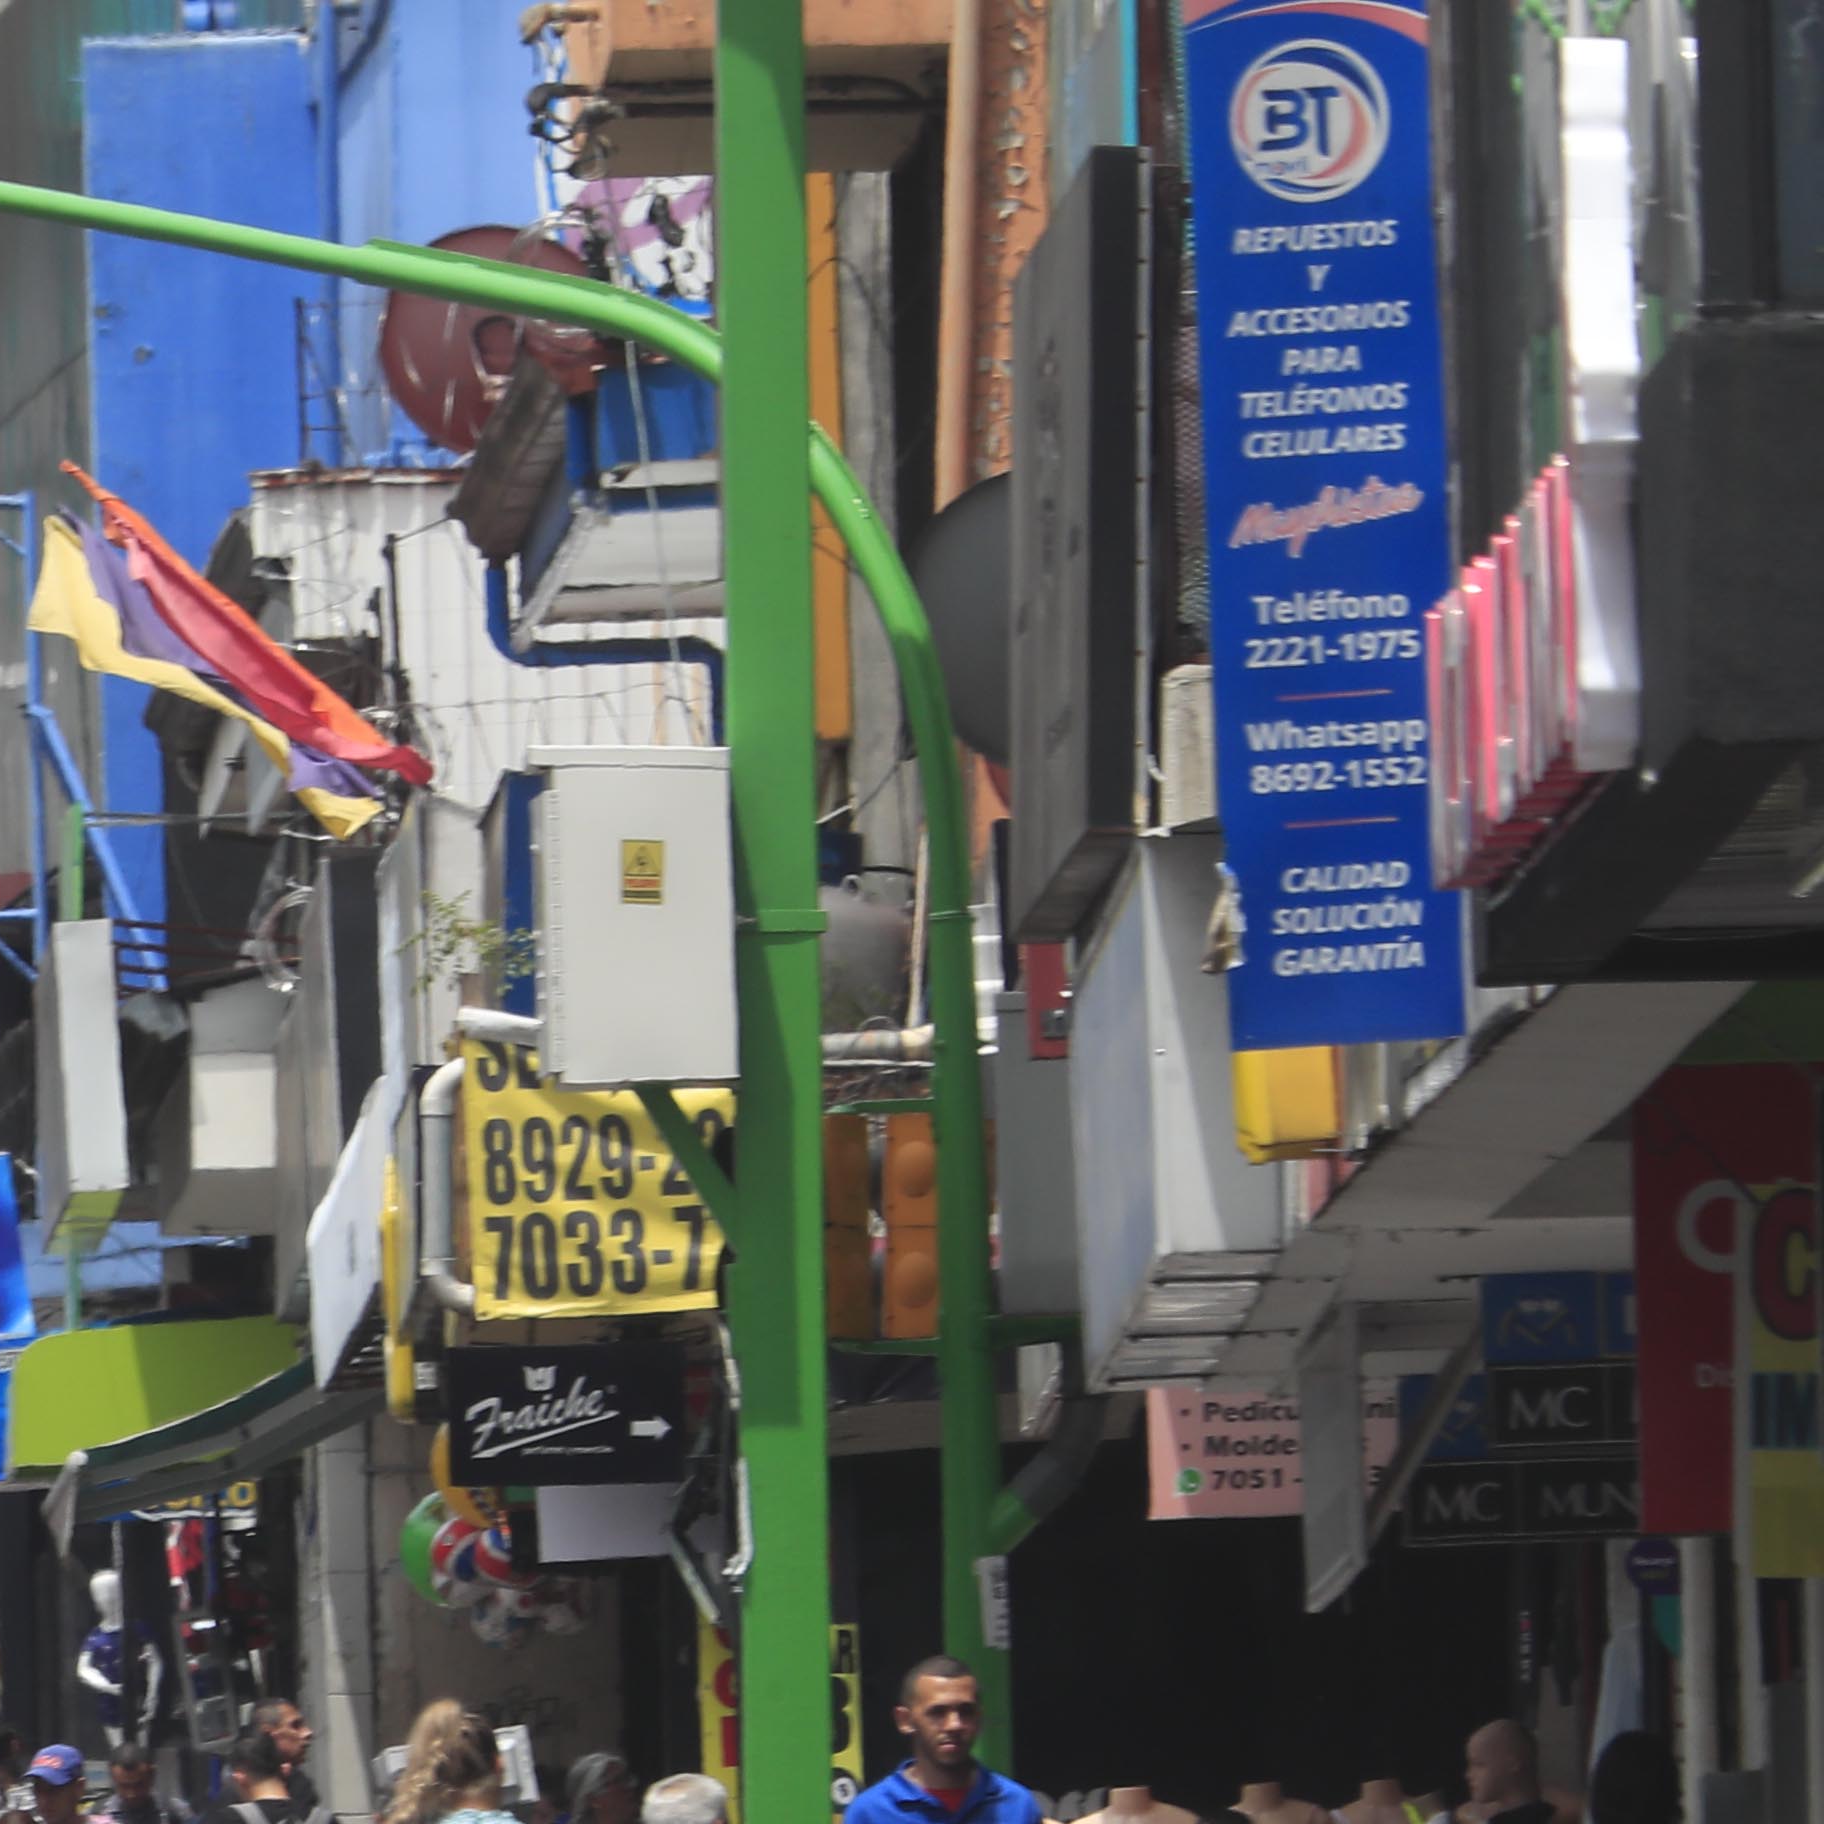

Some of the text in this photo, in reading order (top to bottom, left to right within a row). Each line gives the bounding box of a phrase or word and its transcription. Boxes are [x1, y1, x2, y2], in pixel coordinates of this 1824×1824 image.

[1259, 85, 1340, 157] BT
[1232, 219, 1399, 255] REPUESTOS
[1307, 264, 1332, 292] Y
[1226, 300, 1412, 338] ACCESORIOS
[1281, 345, 1362, 376] PARA
[1238, 382, 1411, 420] TELÉFONOS
[1241, 423, 1408, 459] CELULARES
[1250, 589, 1411, 626] Teléfono
[1244, 629, 1422, 669] 2221-1975
[1245, 718, 1427, 753] Whatsapp
[1250, 756, 1428, 795] 8692-1552
[1280, 860, 1412, 893] CALIDAD
[1270, 895, 1425, 935] SOLUCIÓN
[1272, 935, 1427, 977] GARANTÍA
[464, 1376, 607, 1452] Fraiche
[1508, 1386, 1592, 1430] MC
[1211, 1468, 1284, 1491] 7051
[1421, 1481, 1504, 1523] MC
